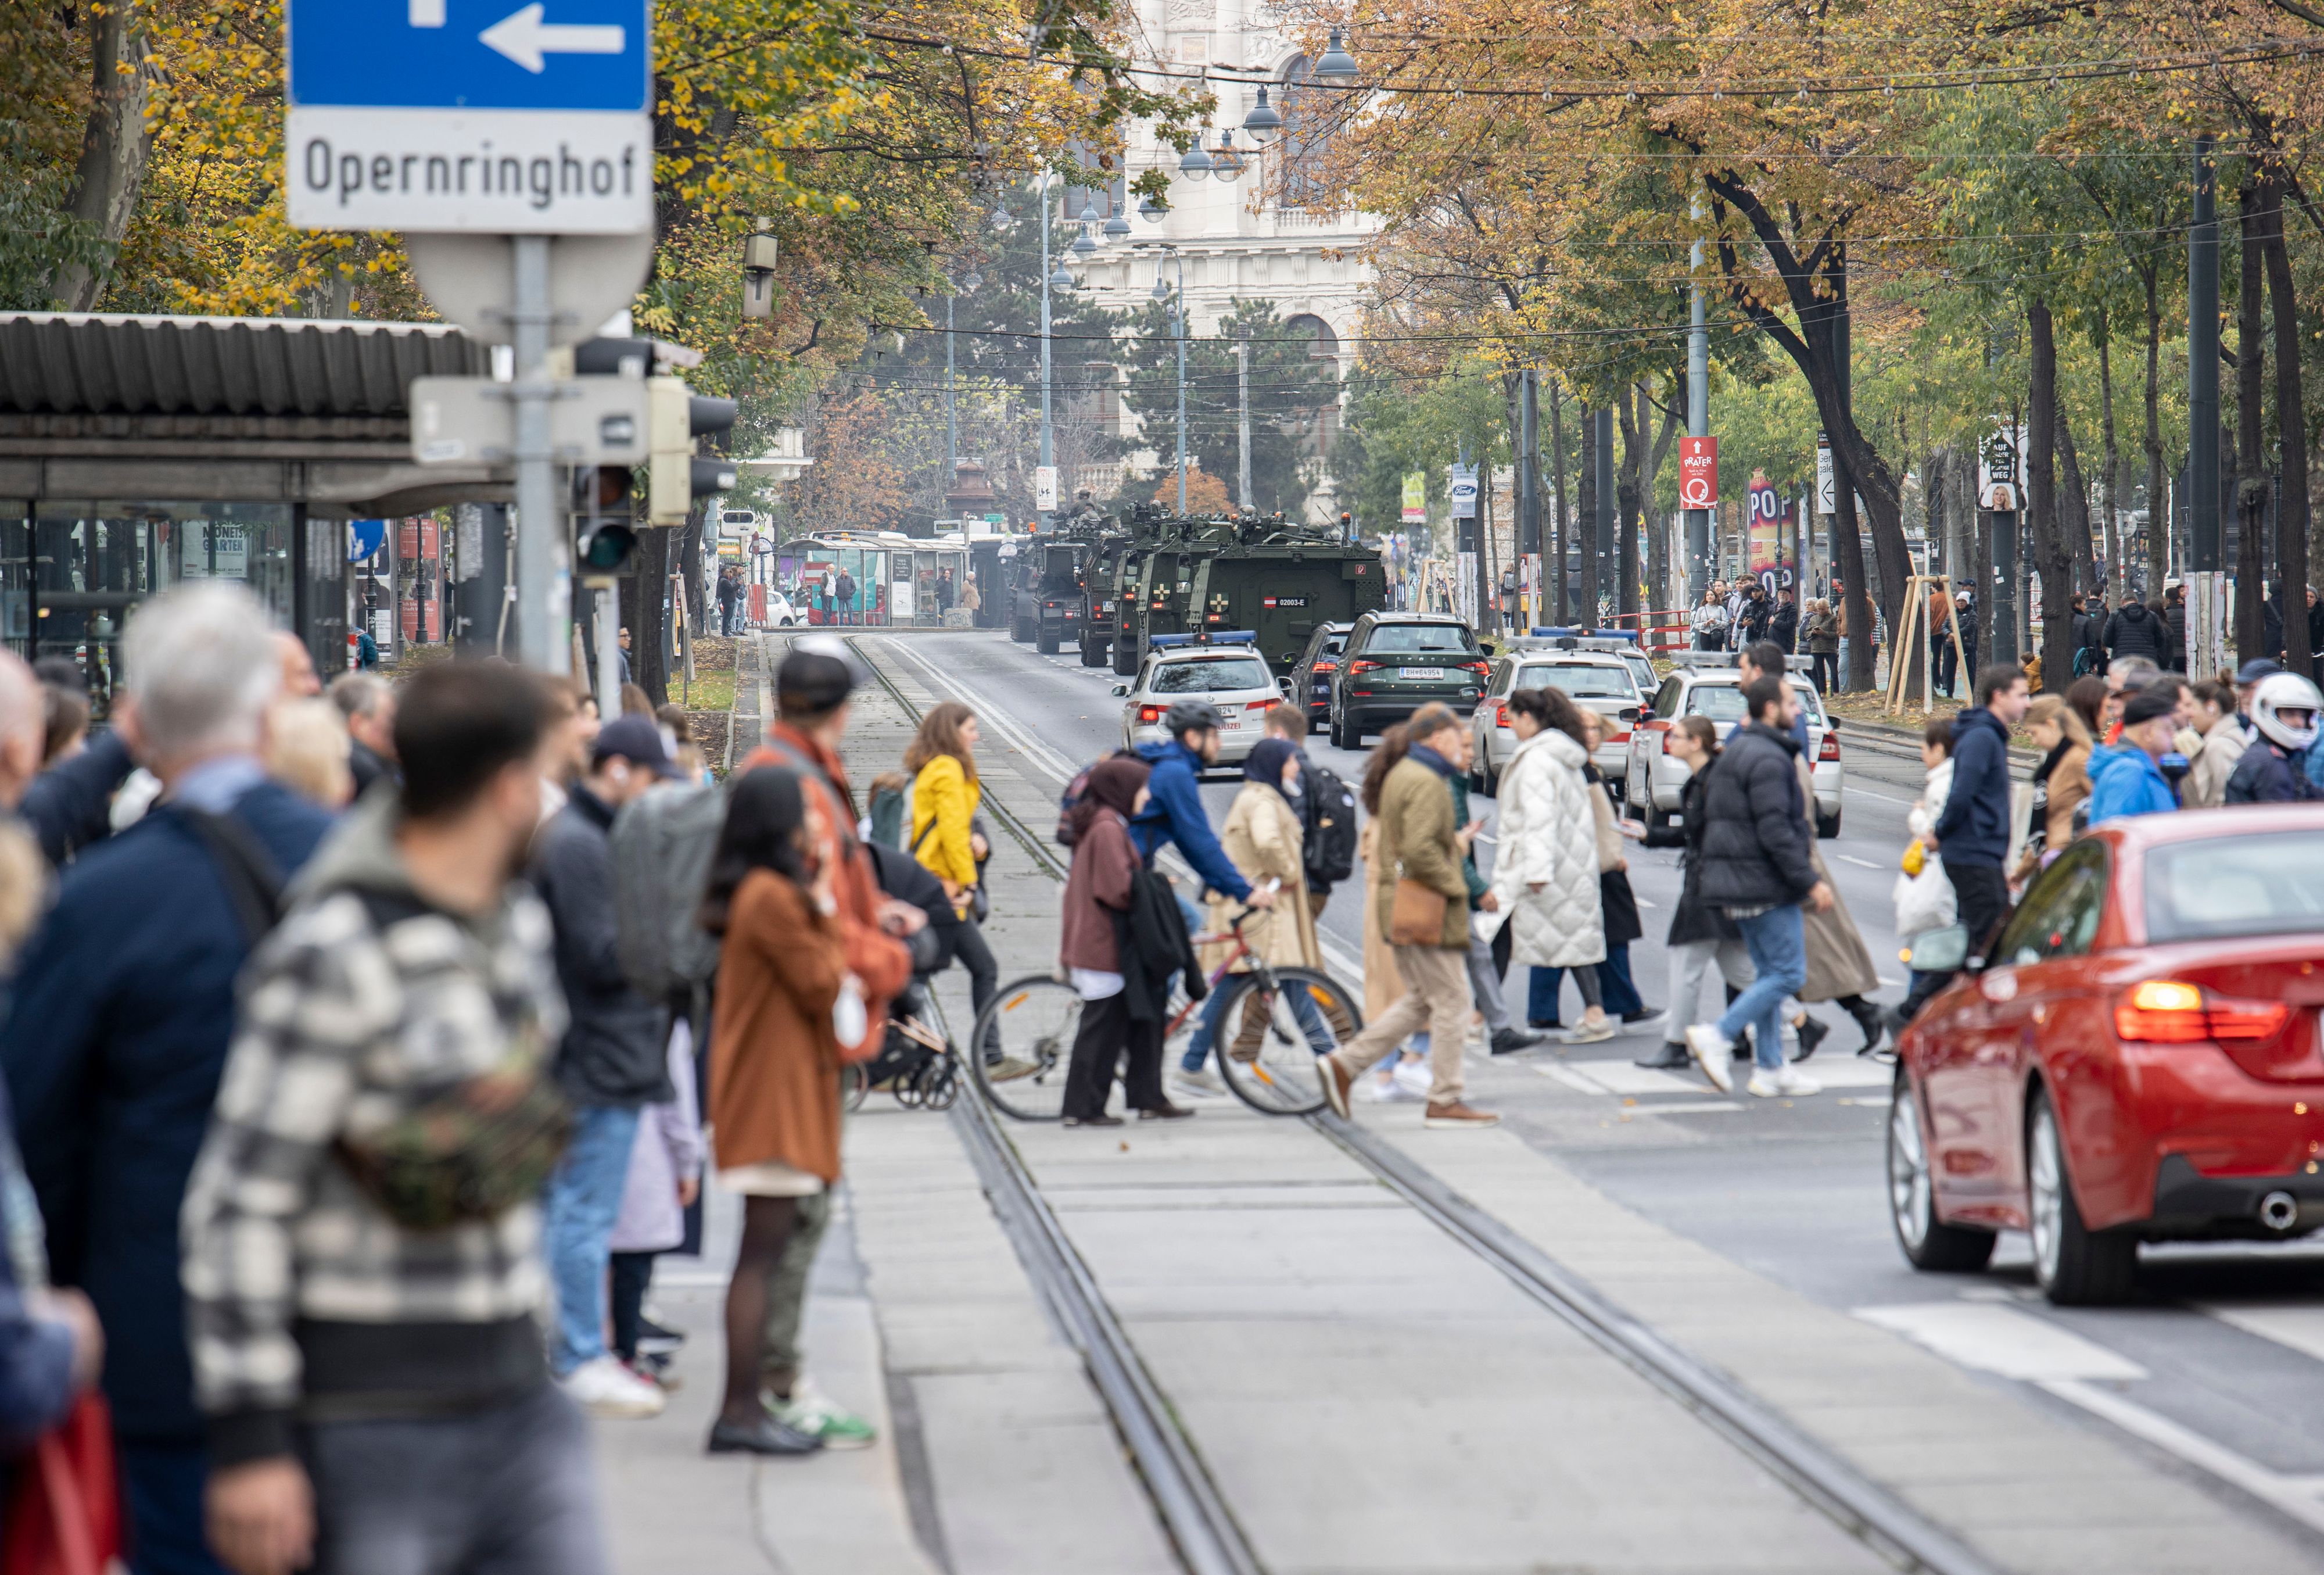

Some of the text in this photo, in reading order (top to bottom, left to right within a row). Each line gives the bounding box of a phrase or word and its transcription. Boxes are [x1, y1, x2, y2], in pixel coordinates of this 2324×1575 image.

[306, 138, 634, 210] Opernringhof
[1684, 456, 1712, 468] PRATER
[1454, 486, 1472, 495] Ford
[1751, 490, 1791, 521] POP
[1762, 569, 1793, 598] OP
